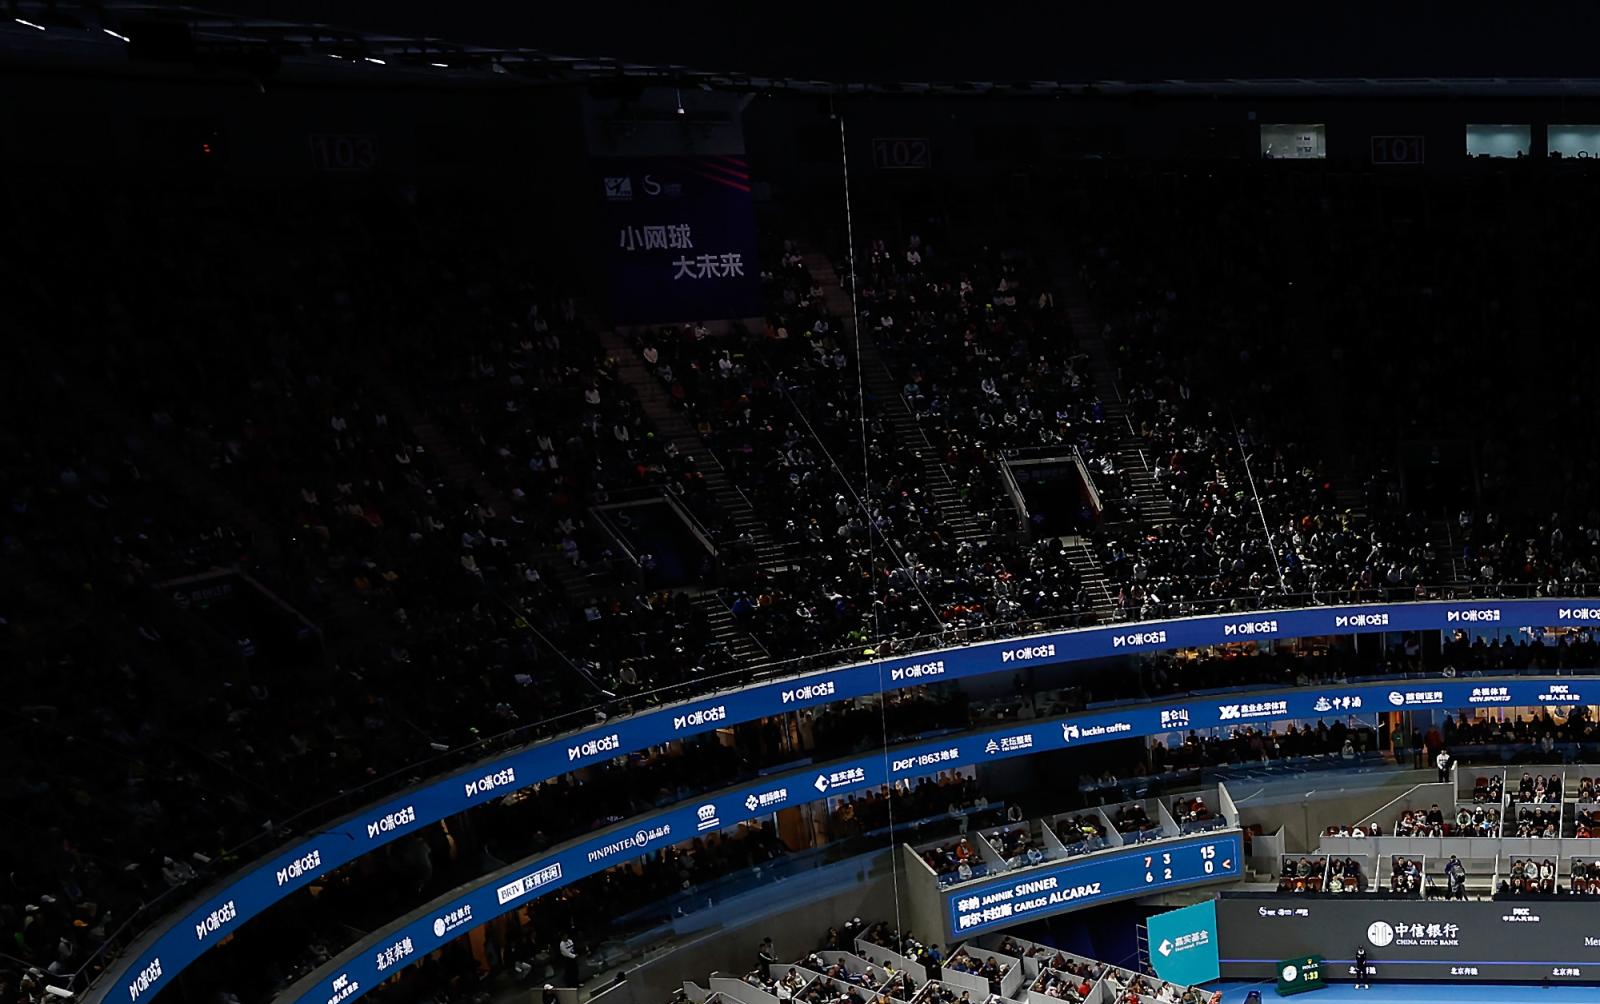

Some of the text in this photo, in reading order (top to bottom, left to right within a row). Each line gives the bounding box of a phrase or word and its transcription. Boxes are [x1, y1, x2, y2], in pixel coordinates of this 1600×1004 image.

[619, 225, 693, 251] 小网球
[672, 253, 744, 280] 大未来
[1161, 709, 1189, 723] 昆仑山
[1082, 723, 1131, 737] luckin coffee
[588, 837, 636, 862] PINPINTEA
[981, 889, 1013, 906] JANNIK
[1015, 877, 1058, 898] SINNER
[1145, 857, 1152, 868] 7
[1163, 854, 1171, 865] 3
[1201, 846, 1215, 859] 15
[1014, 898, 1047, 913] CARLOS
[1049, 883, 1101, 904] ALCARAZ
[1145, 872, 1153, 883] 6
[1164, 868, 1172, 880] 2
[1204, 860, 1213, 873] 0
[1395, 923, 1459, 938] 中信银行
[377, 937, 413, 970] 北京奔驰
[1304, 971, 1319, 981] 1:33
